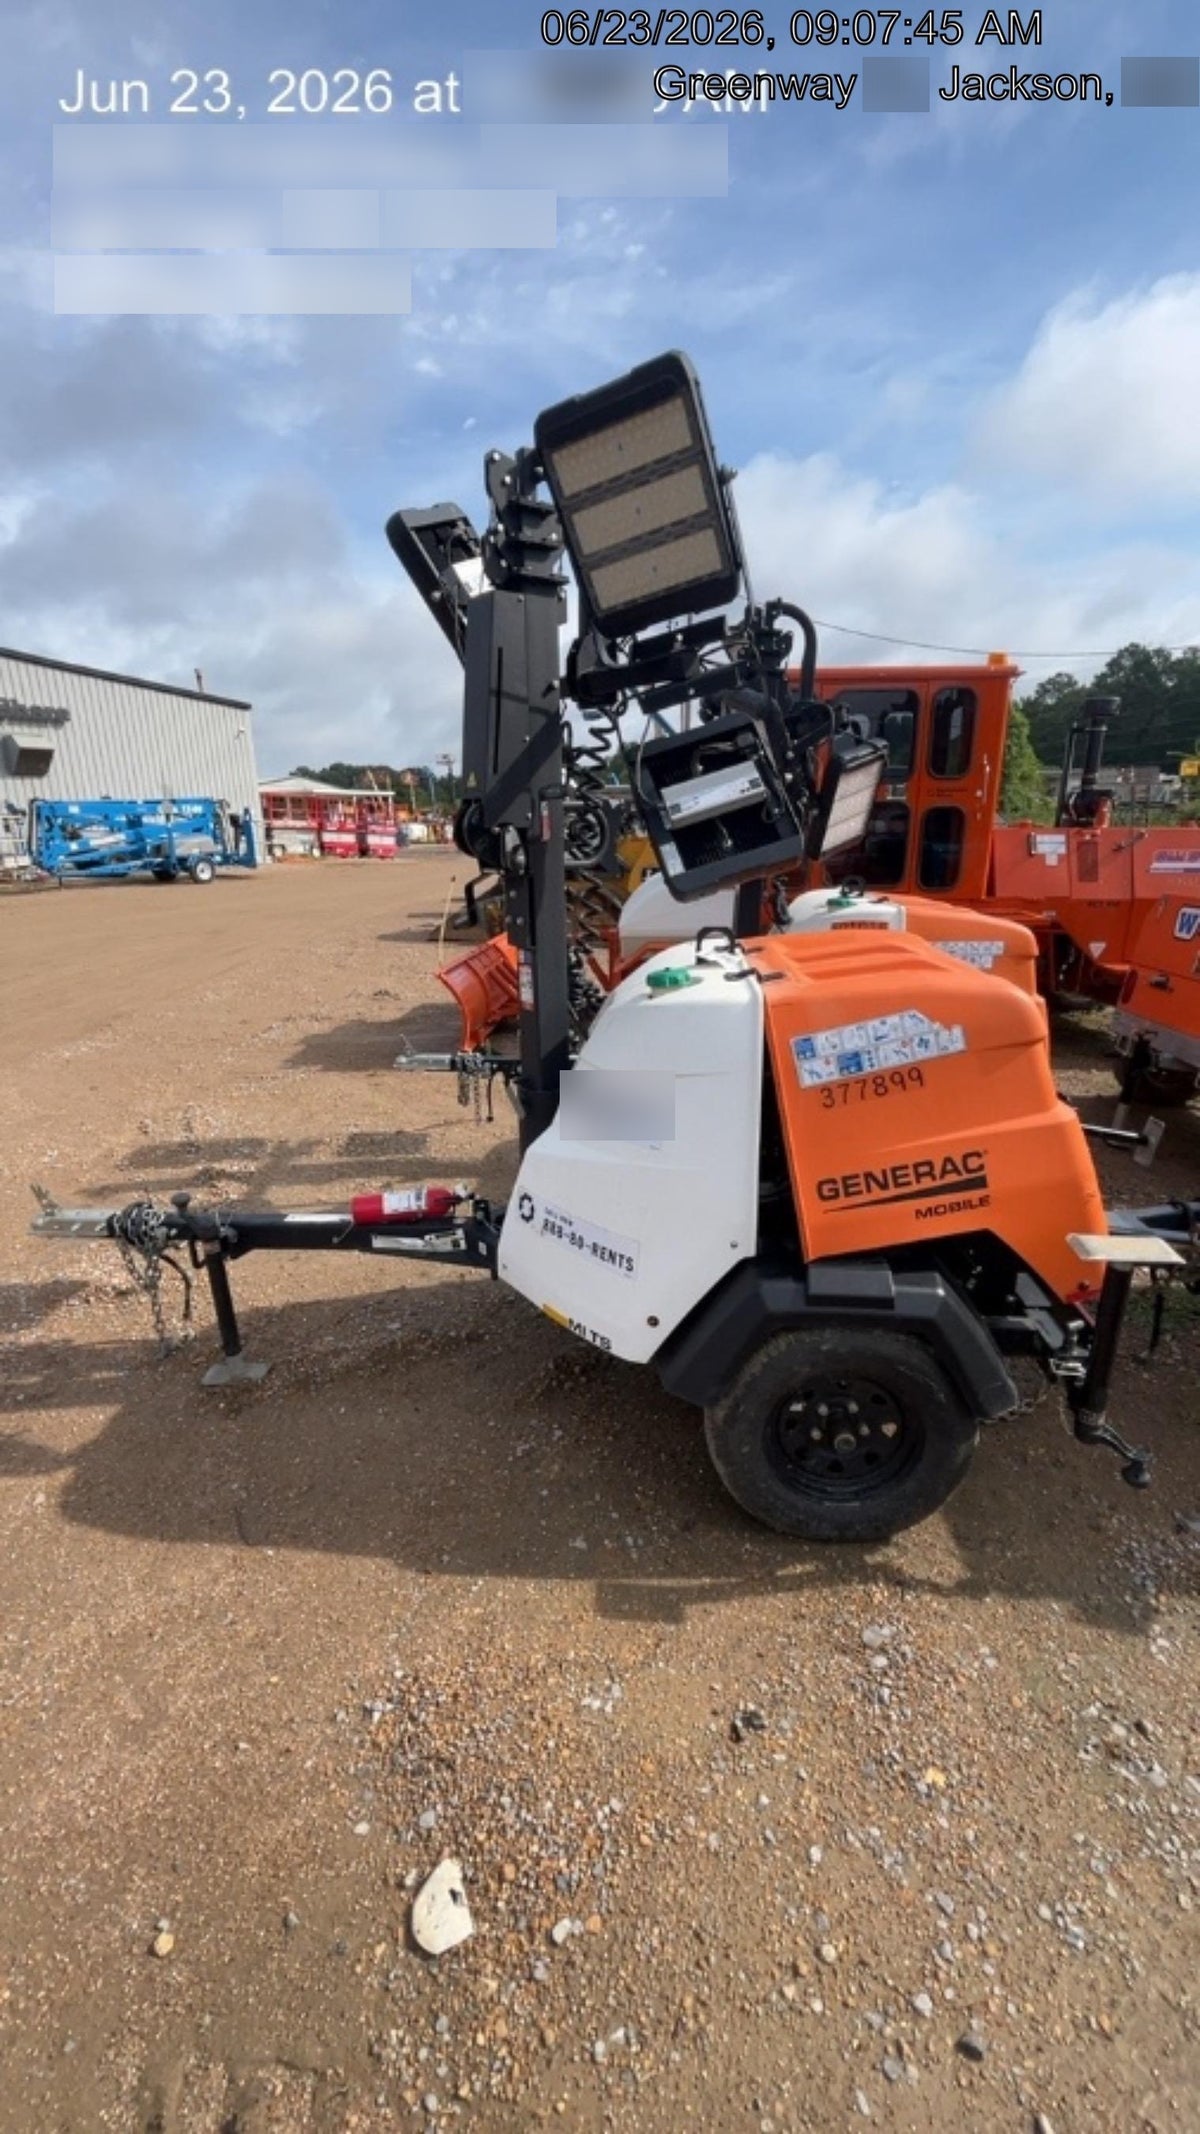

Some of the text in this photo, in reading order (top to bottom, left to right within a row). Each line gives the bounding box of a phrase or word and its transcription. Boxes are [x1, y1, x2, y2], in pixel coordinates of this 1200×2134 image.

[820, 1066, 924, 1109] 377899
[816, 1150, 987, 1202] GENERAC
[915, 1195, 990, 1220] MOBILE
